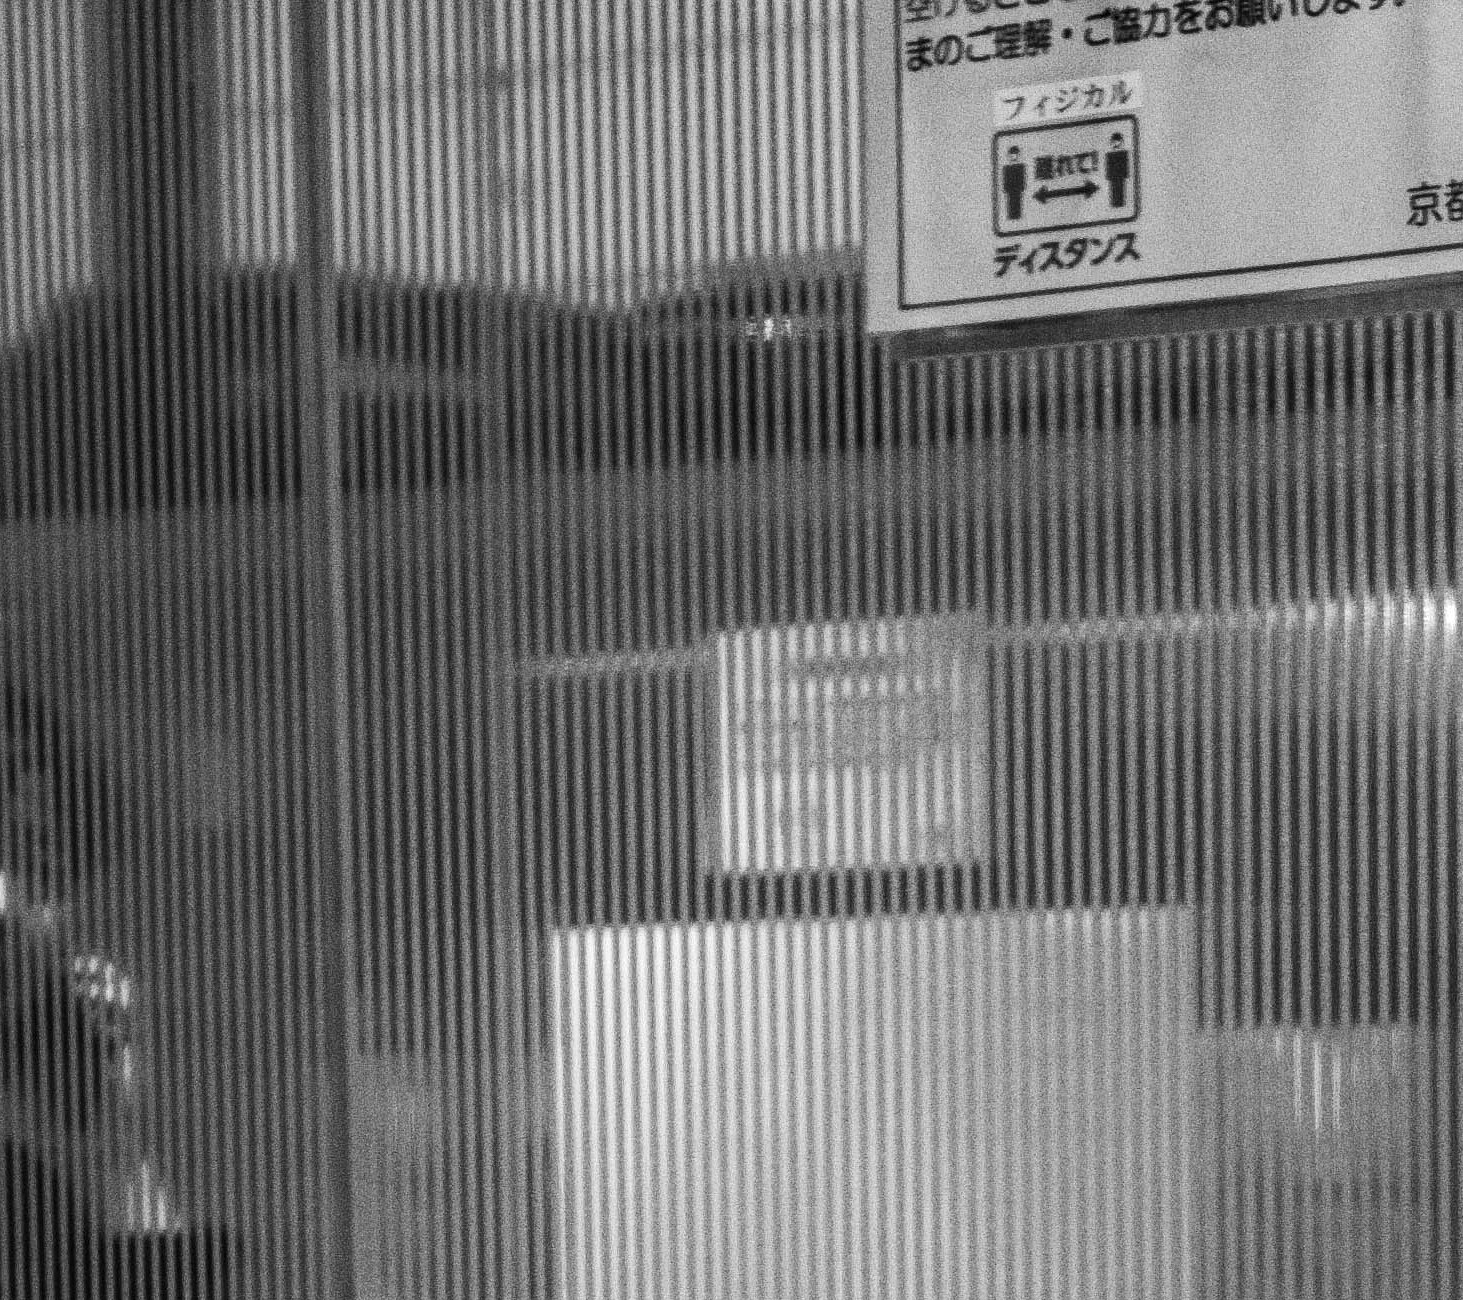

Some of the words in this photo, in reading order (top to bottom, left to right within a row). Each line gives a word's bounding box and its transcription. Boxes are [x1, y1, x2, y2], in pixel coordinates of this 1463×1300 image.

[1002, 80, 1134, 121] フィジカル
[993, 231, 1141, 278] ディスタンス
